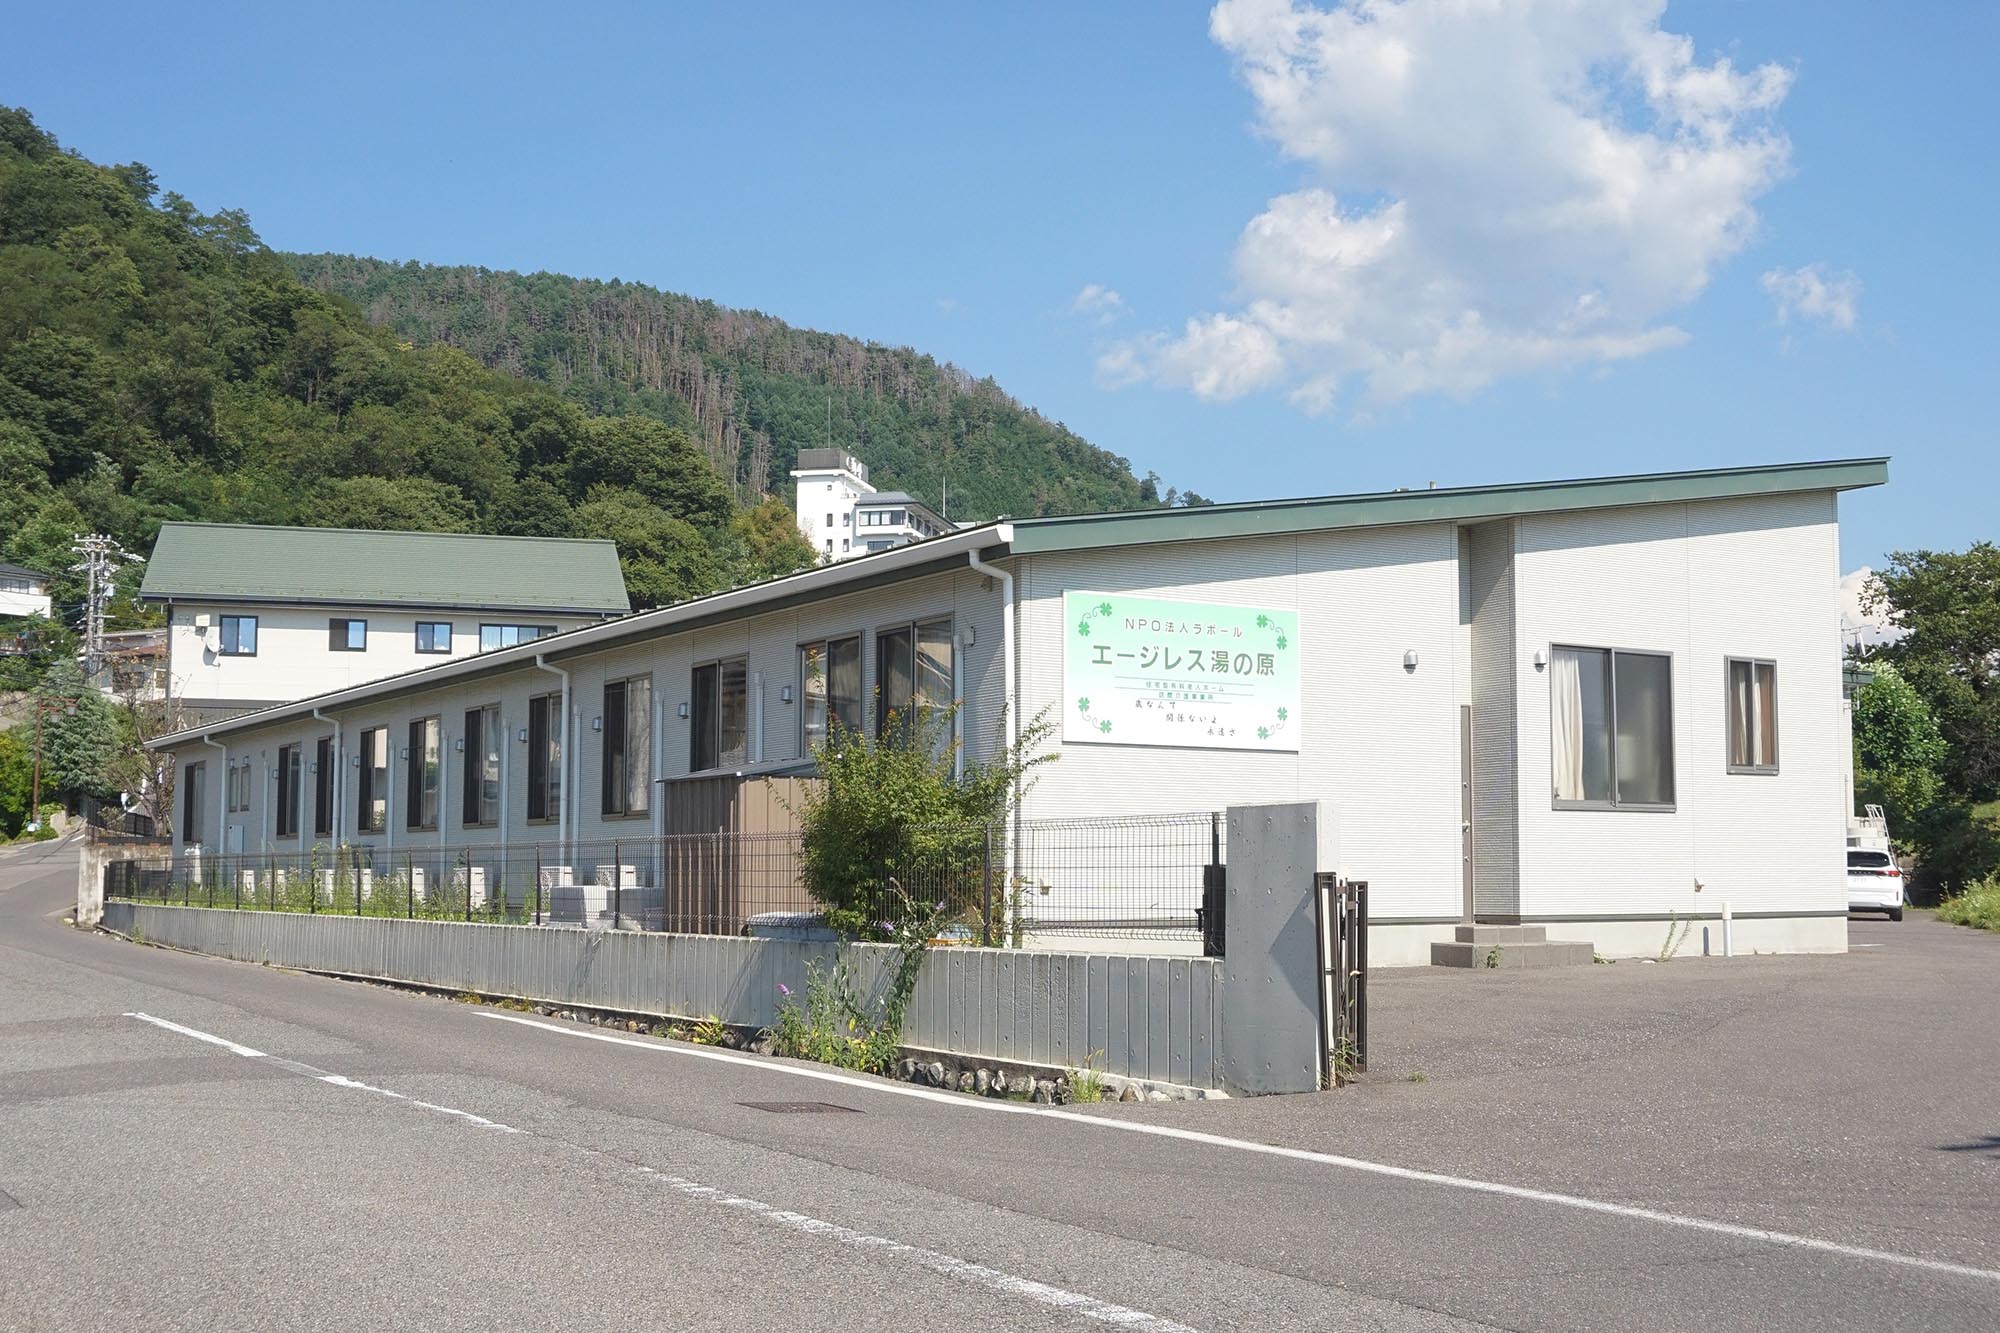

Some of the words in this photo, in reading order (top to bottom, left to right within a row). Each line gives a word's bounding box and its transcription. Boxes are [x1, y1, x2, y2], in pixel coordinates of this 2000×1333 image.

[1092, 644, 1275, 676] エージレス湯の原
